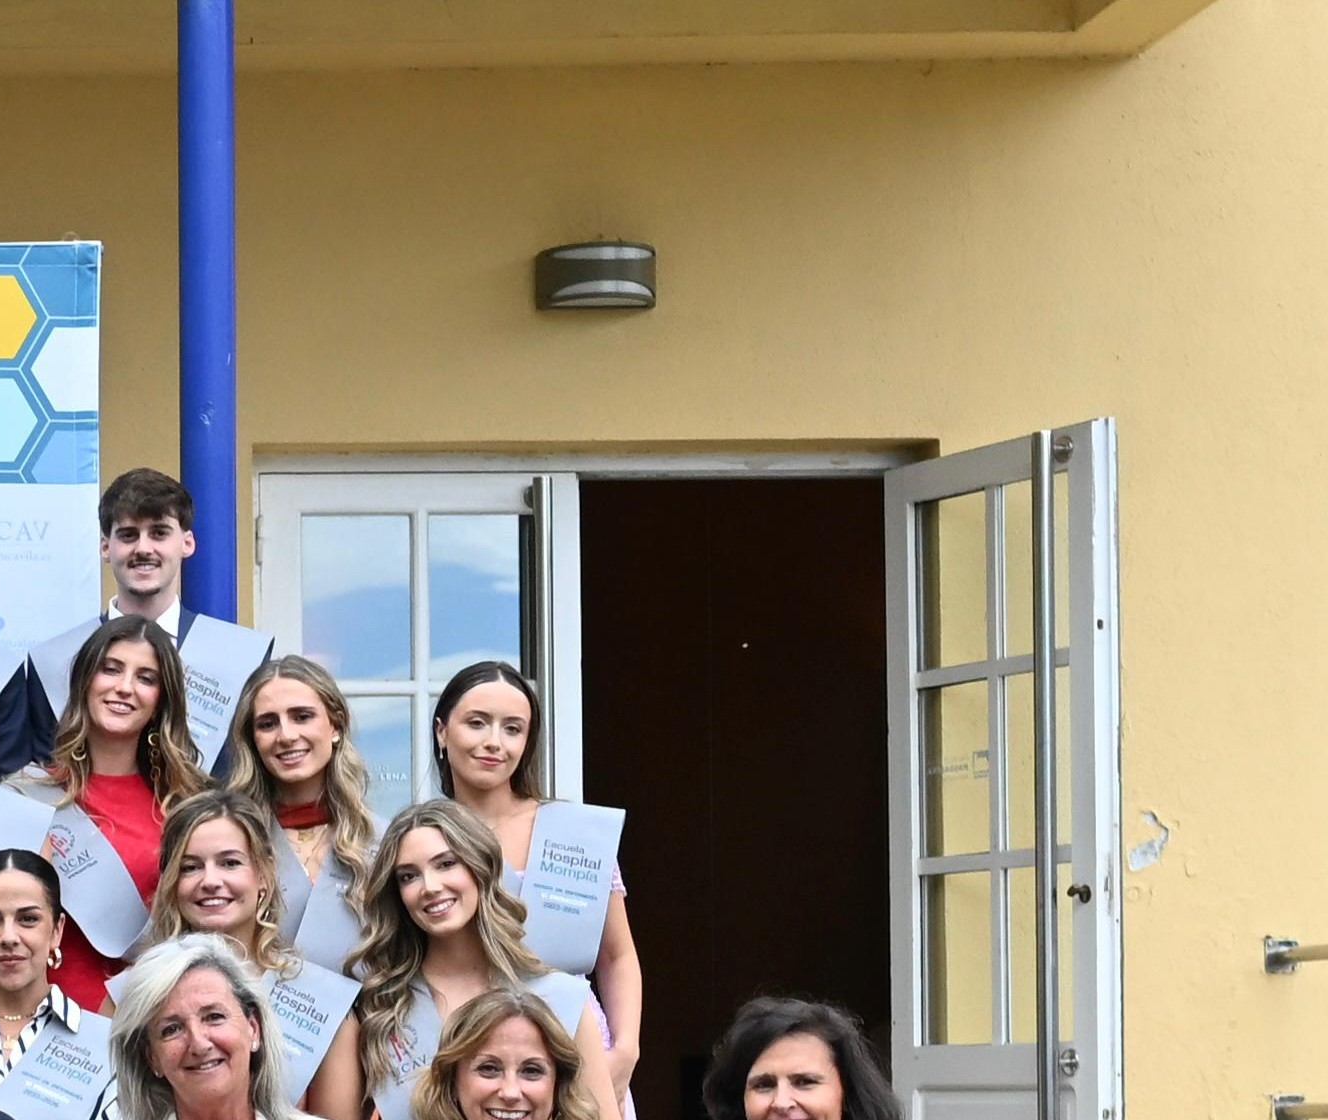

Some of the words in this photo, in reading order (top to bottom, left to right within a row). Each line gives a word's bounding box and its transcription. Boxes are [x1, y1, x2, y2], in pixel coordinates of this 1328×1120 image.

[541, 847, 602, 871] Hospital
[543, 838, 586, 855] Escuela
[58, 848, 91, 873] UCAV
[539, 859, 598, 884] Mompía
[273, 979, 317, 1005] Escuela
[269, 986, 330, 1025] Hospital
[50, 1034, 92, 1057] Escuela
[35, 1052, 93, 1085] Mompía
[43, 1042, 104, 1075] Hospital
